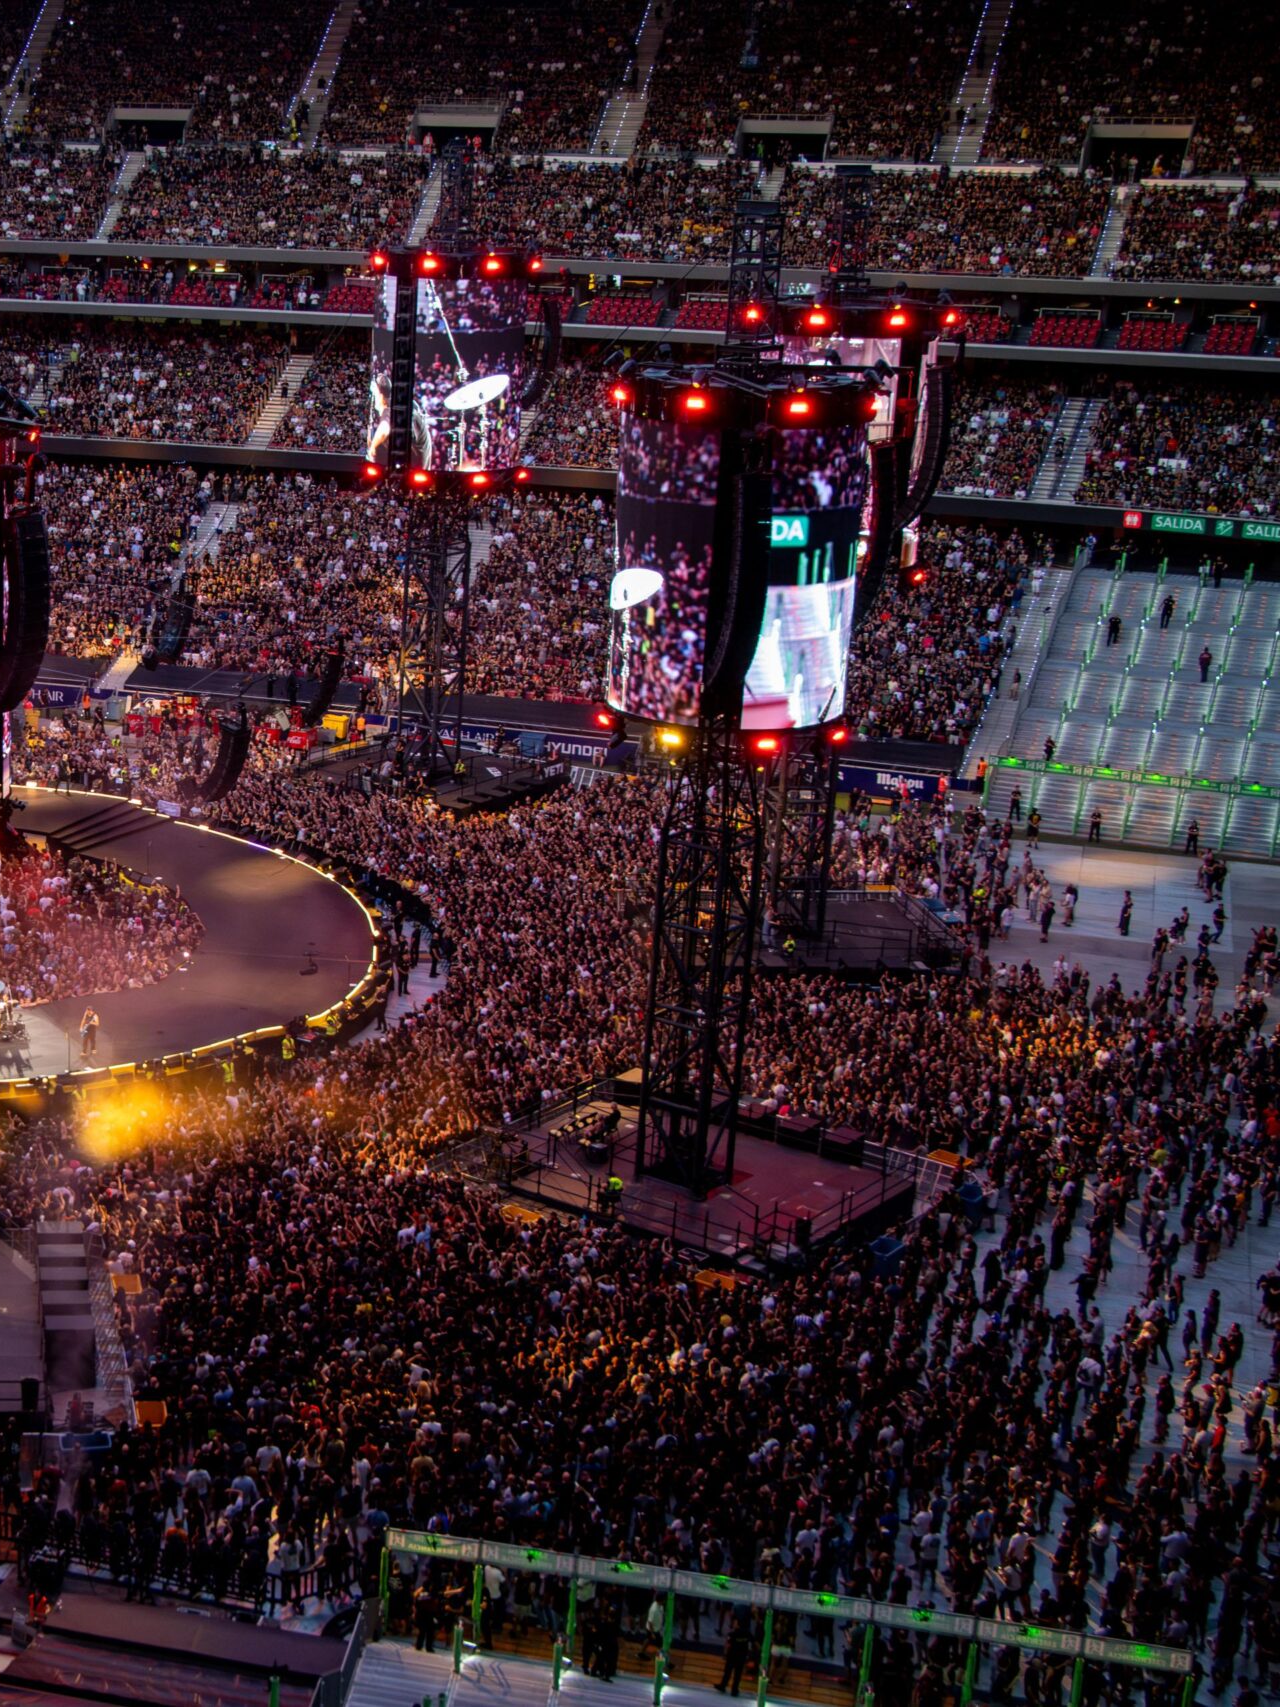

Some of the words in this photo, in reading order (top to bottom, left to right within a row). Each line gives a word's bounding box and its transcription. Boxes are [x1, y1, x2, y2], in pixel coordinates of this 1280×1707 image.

[771, 519, 804, 541] DA
[1155, 516, 1203, 531] SALIDA
[543, 762, 564, 778] YETI
